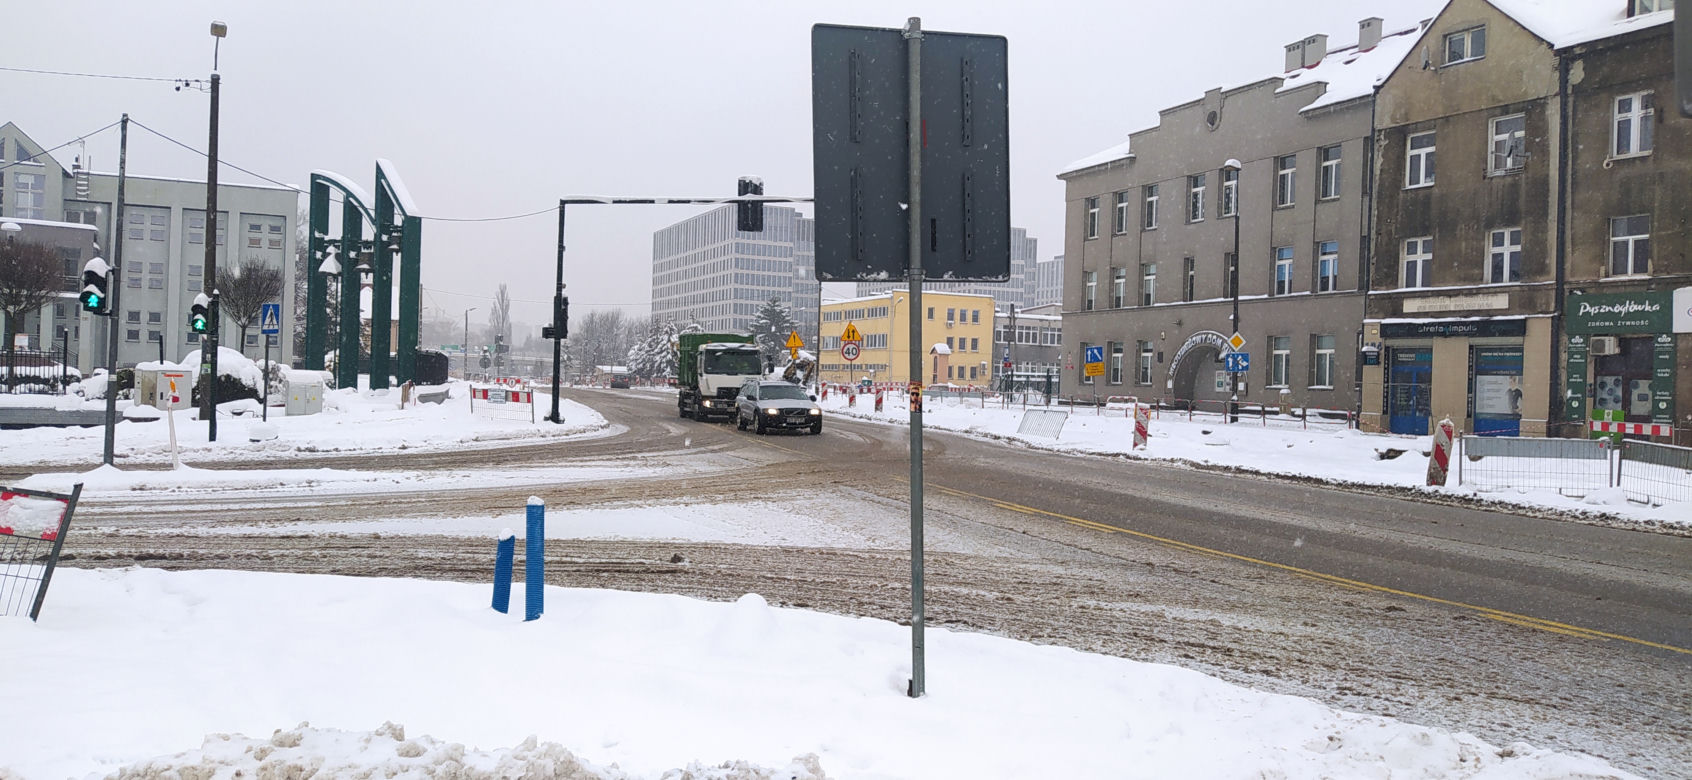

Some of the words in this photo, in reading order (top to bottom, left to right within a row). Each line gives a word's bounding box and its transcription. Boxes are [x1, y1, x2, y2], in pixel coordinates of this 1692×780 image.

[1579, 300, 1660, 317] Pysznogłówka
[1207, 333, 1223, 348] DOM
[845, 347, 857, 356] 40
